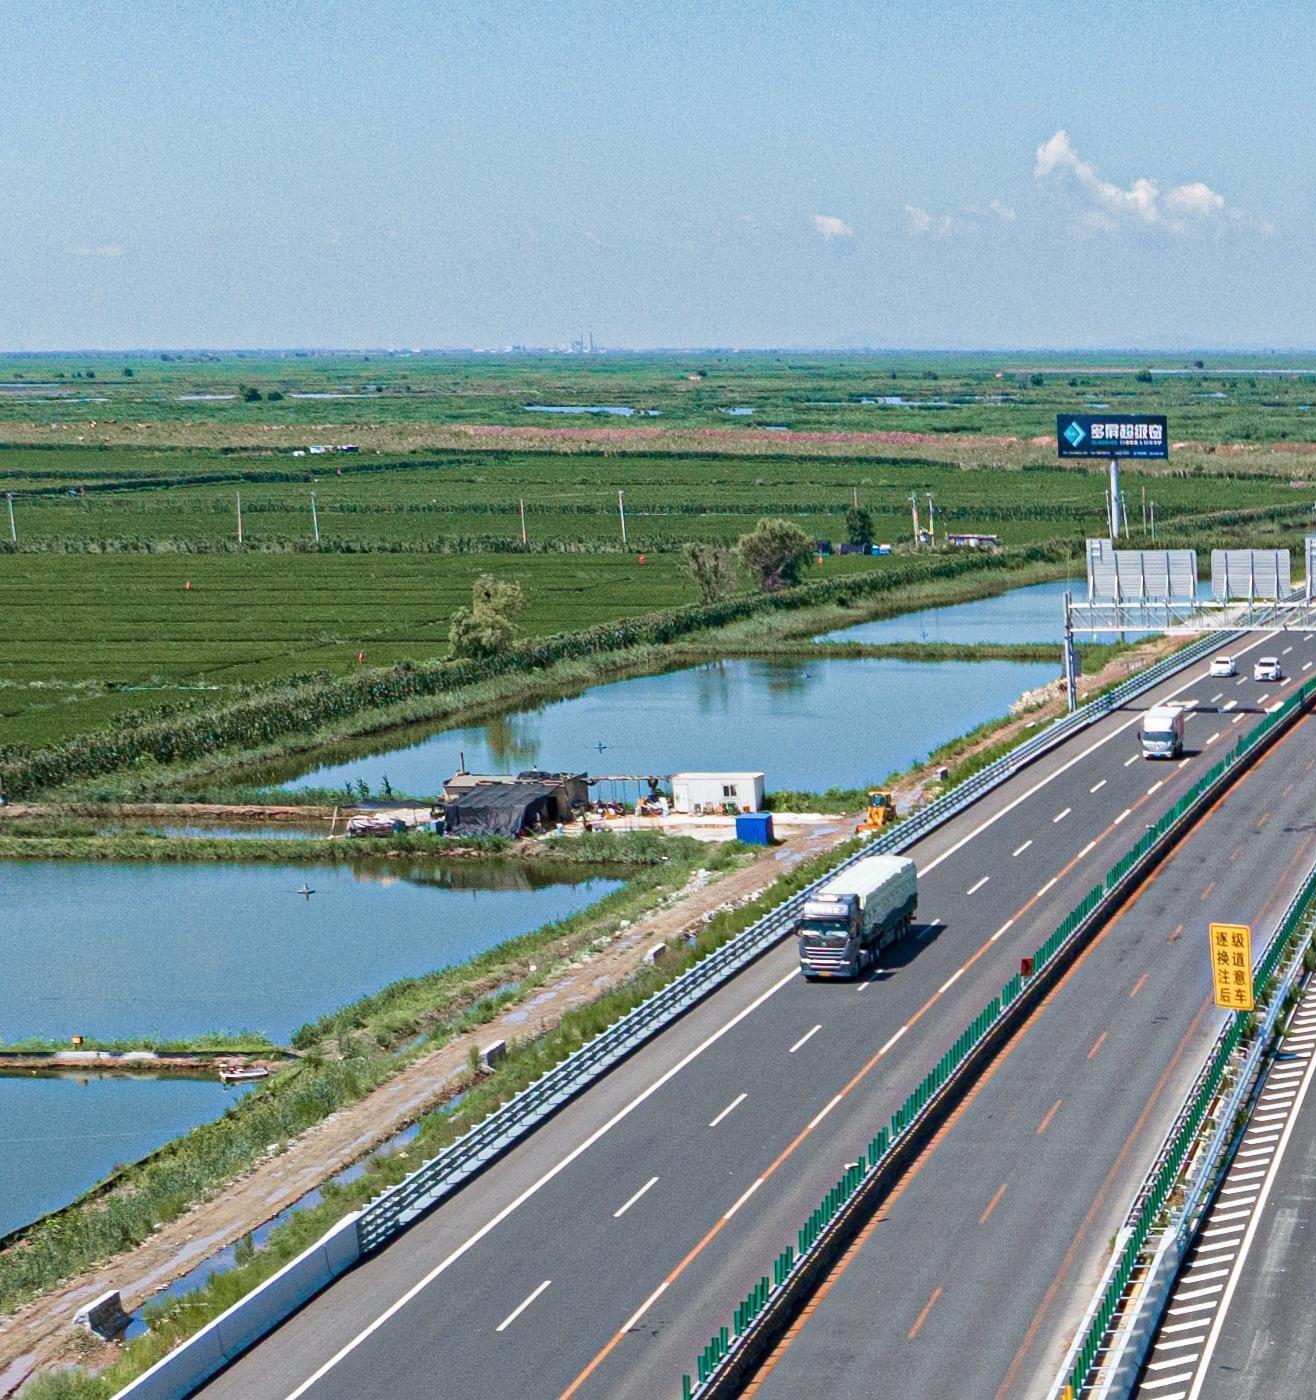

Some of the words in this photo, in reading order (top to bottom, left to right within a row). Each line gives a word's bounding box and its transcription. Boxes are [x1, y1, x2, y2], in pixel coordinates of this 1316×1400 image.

[1216, 932, 1245, 948] 逐级
[1217, 950, 1245, 967] 换道
[1218, 969, 1246, 985] 注意
[1219, 988, 1247, 1003] 后车
